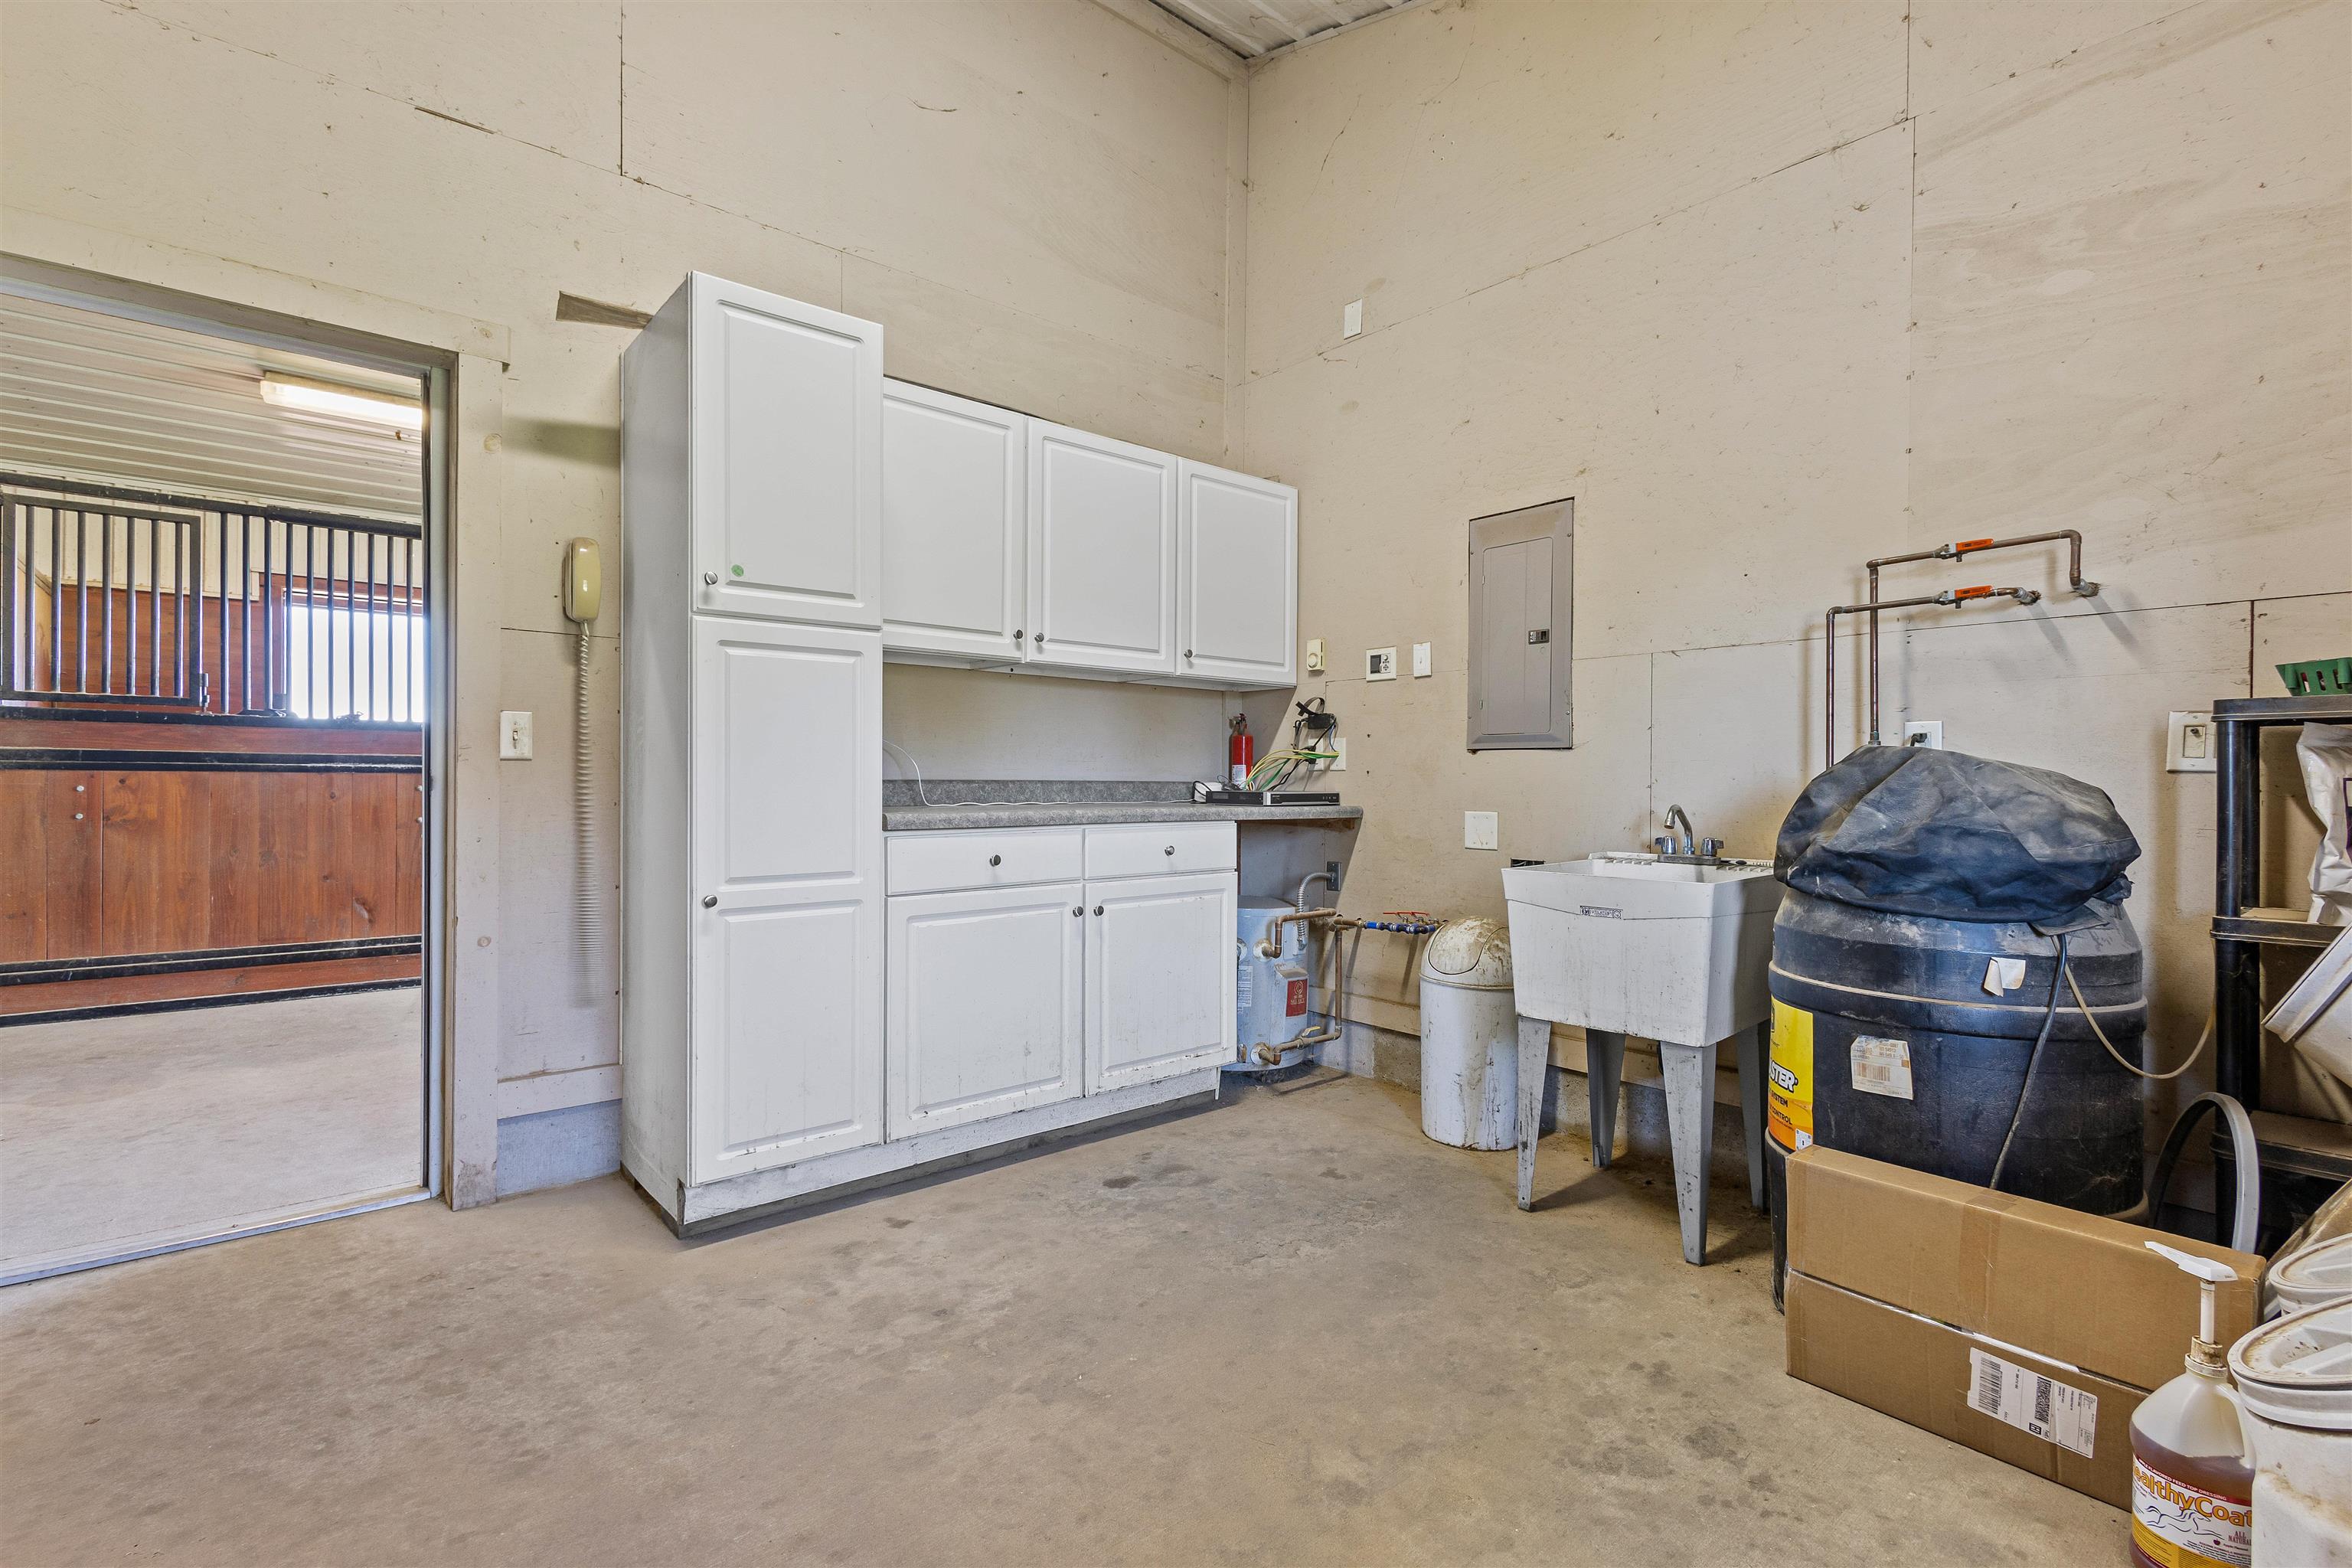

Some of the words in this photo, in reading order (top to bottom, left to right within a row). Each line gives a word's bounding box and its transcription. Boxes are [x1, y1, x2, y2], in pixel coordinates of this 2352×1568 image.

[1769, 1060, 1795, 1093] STER
[2133, 1465, 2252, 1527] ealthyCoat
[2173, 1478, 2187, 1488] FEED
[2198, 1488, 2227, 1501] DRESSING
[2235, 1530, 2246, 1539] ALL
